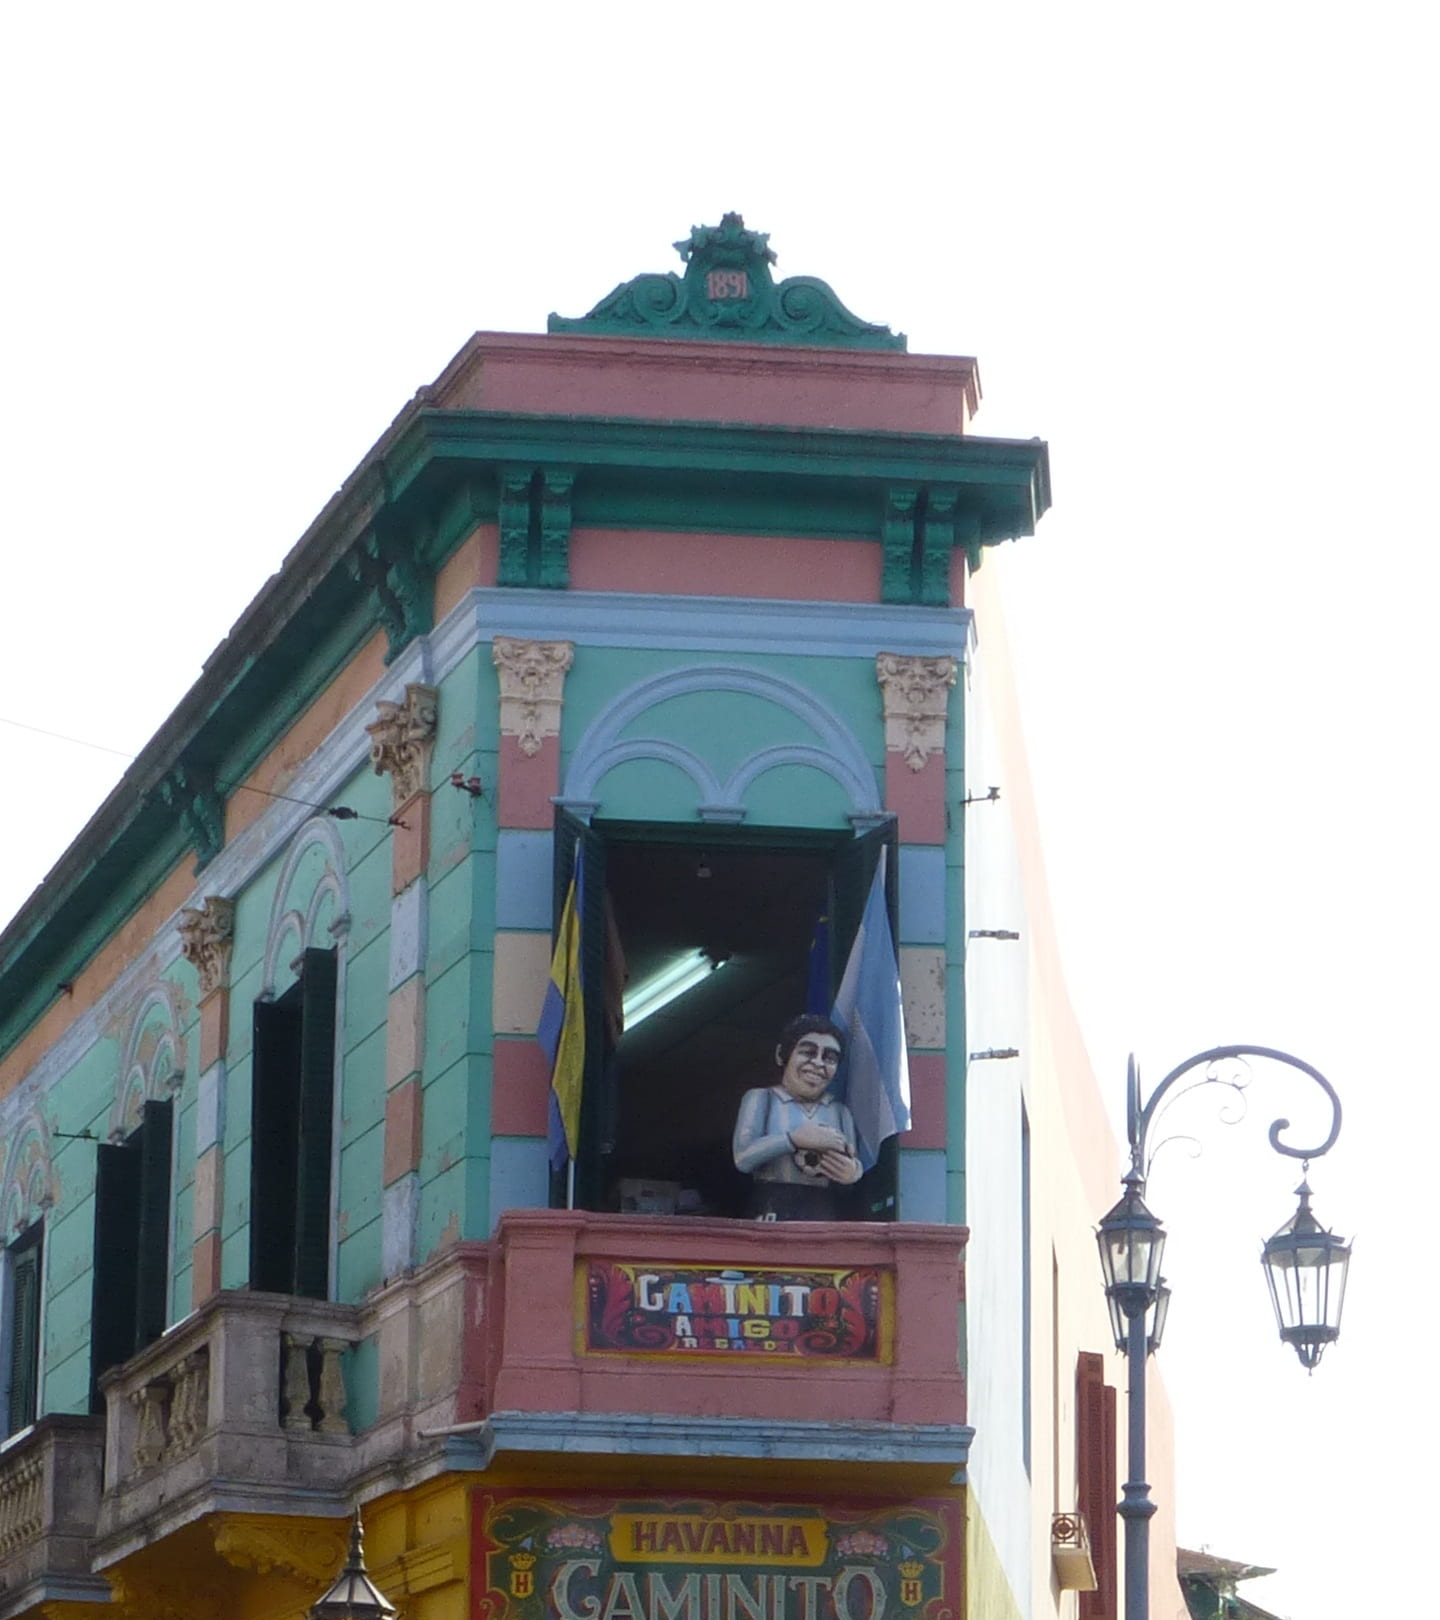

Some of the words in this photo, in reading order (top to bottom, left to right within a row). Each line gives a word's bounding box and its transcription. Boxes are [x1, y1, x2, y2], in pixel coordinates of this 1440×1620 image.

[707, 271, 748, 300] 1891
[675, 1315, 799, 1338] AMIGO
[634, 1520, 809, 1556] HAVANNA
[514, 1573, 529, 1594] H
[904, 1581, 919, 1601] H
